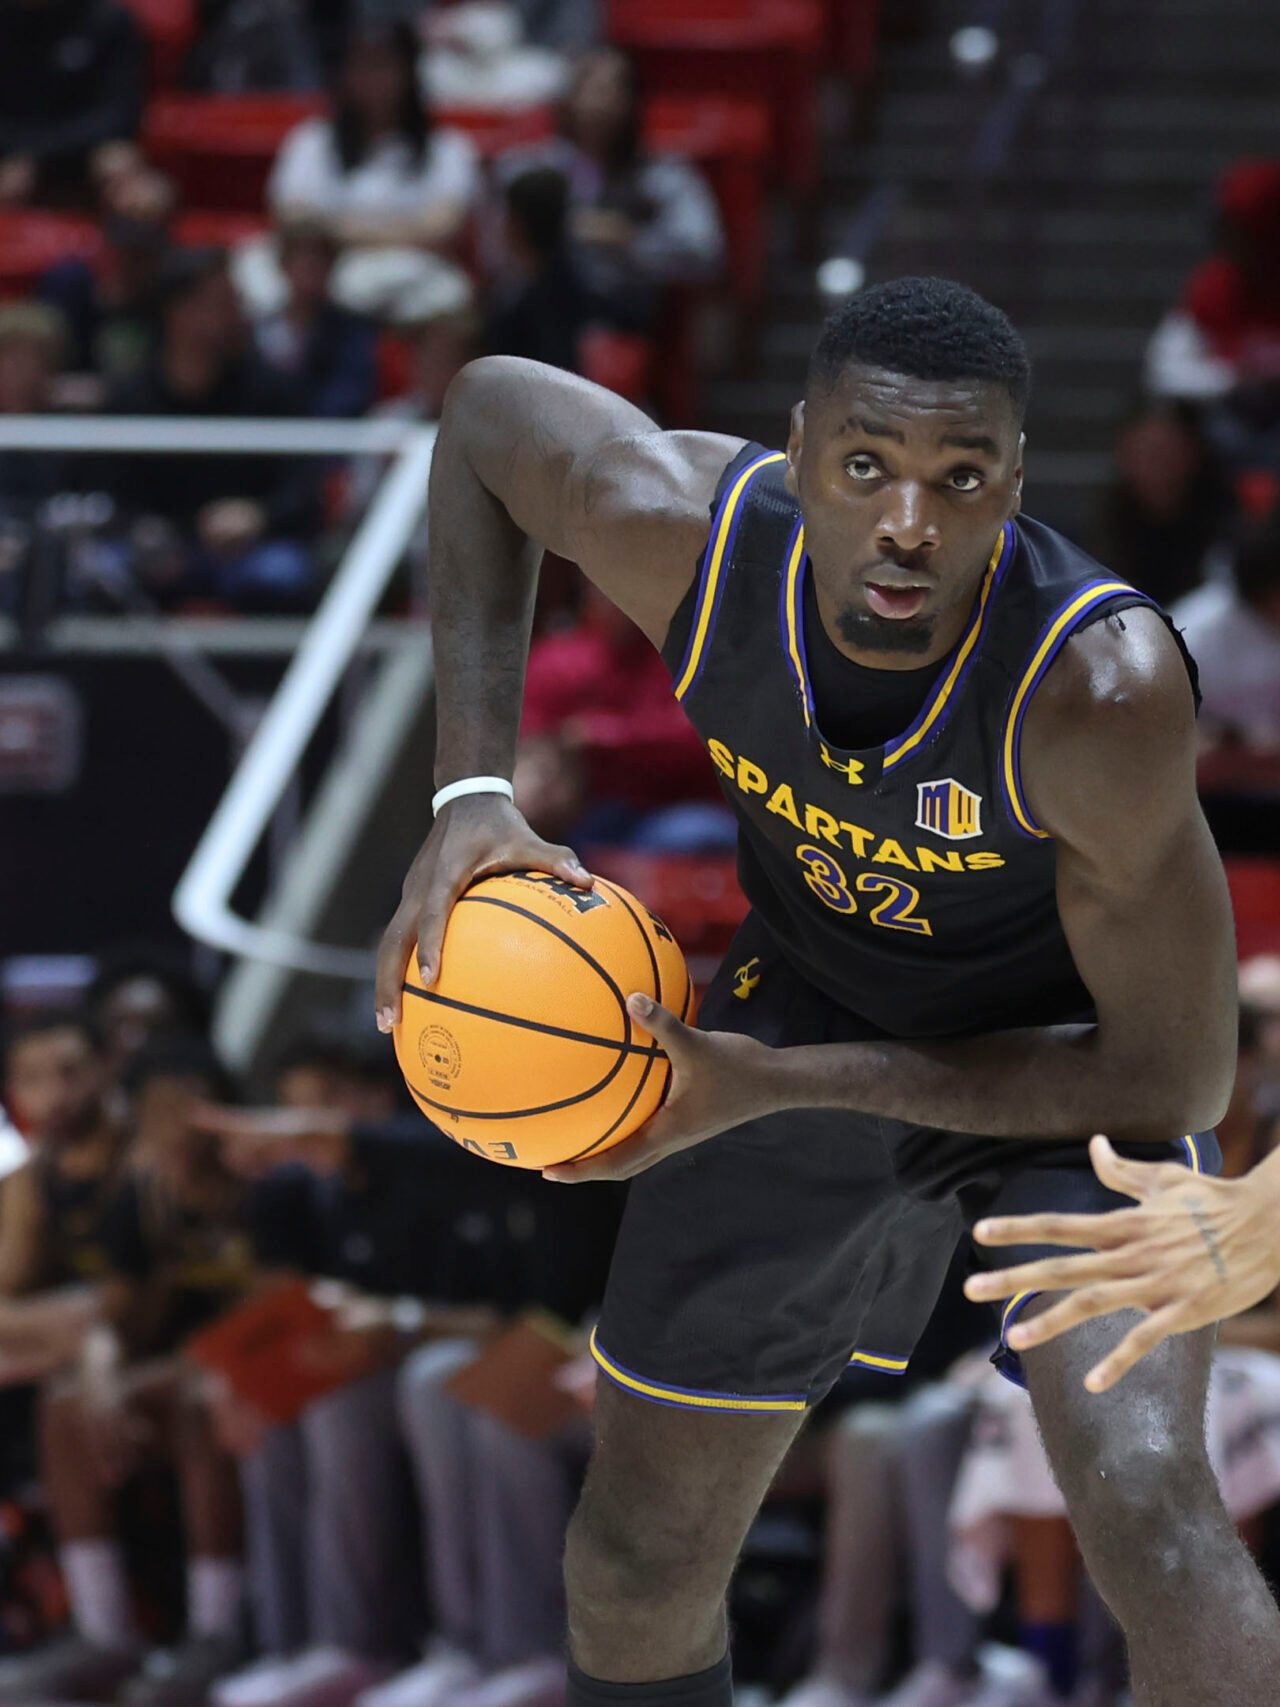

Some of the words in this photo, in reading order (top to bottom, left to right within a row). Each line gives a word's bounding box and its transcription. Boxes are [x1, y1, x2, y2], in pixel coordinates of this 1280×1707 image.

[707, 738, 1006, 873] SPARTANS
[915, 778, 983, 839] MW
[796, 844, 933, 936] 32
